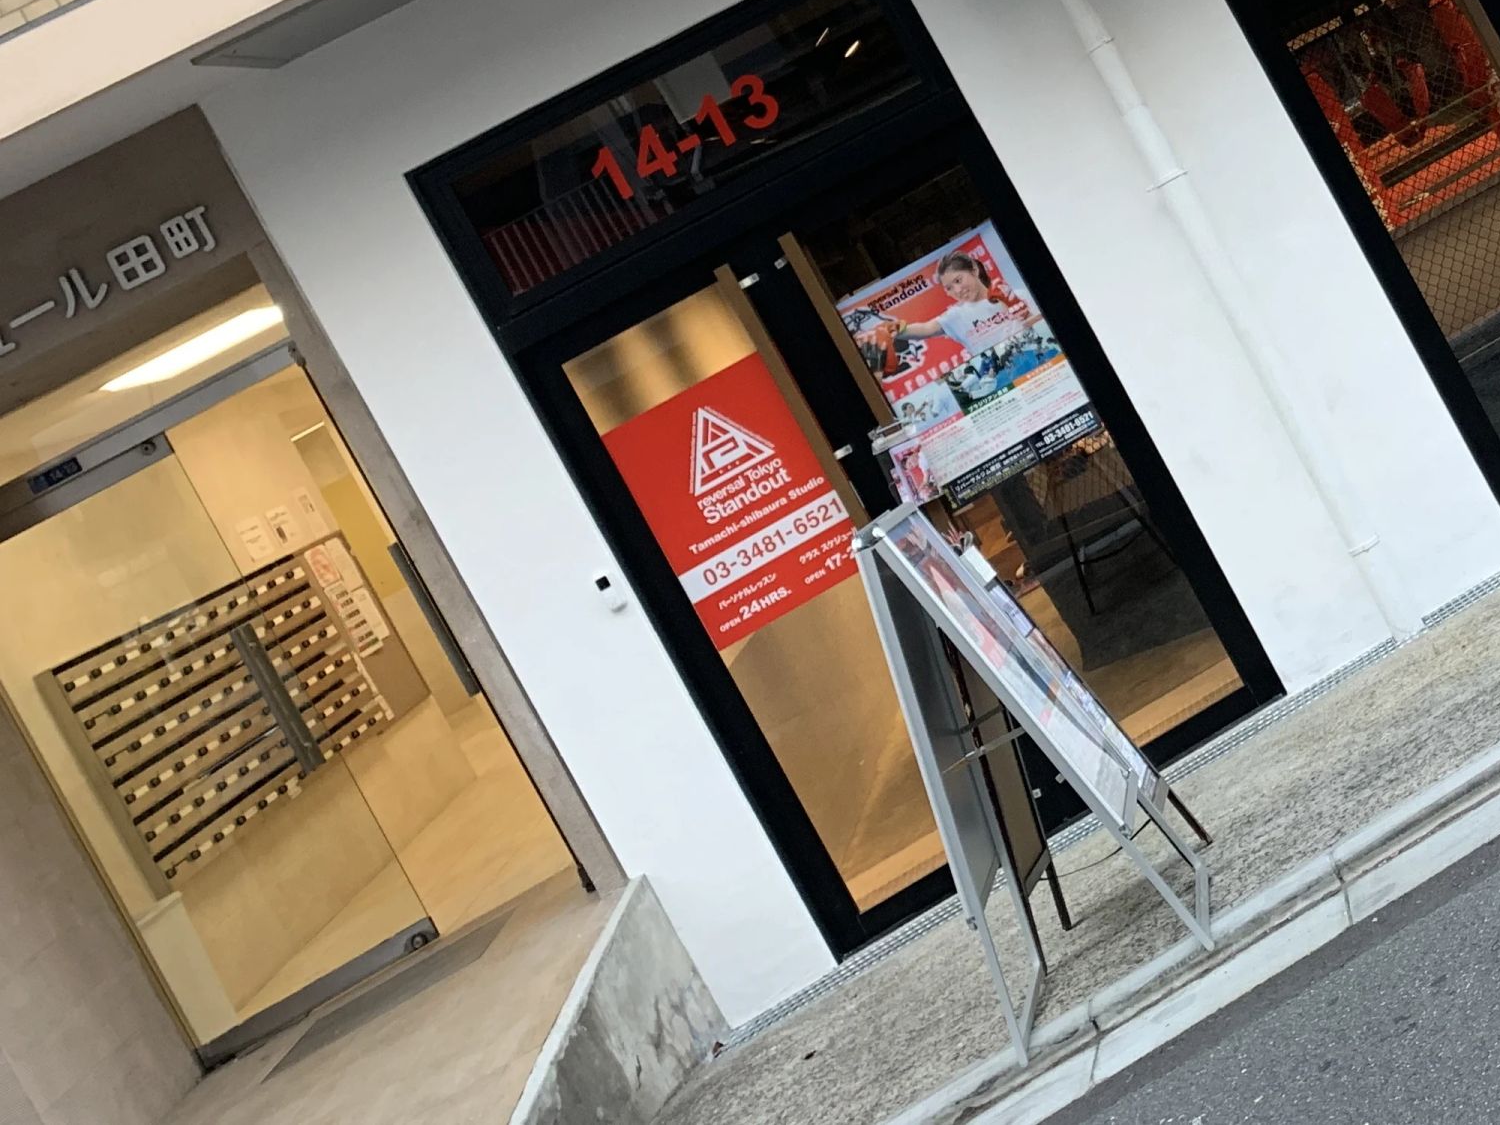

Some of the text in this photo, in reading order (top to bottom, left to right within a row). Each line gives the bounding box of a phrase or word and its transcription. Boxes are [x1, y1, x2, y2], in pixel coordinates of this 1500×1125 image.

[591, 74, 780, 200] 14-13
[697, 458, 781, 509] reversal Tokyo
[704, 468, 790, 524] Standout
[689, 477, 824, 553] Tamachi-shibaura Studio
[704, 498, 841, 585] 03-3481-6521
[800, 548, 820, 563] クラス
[719, 573, 776, 609] パーソナルレッスン
[720, 587, 791, 631] OPEN 24HRS.
